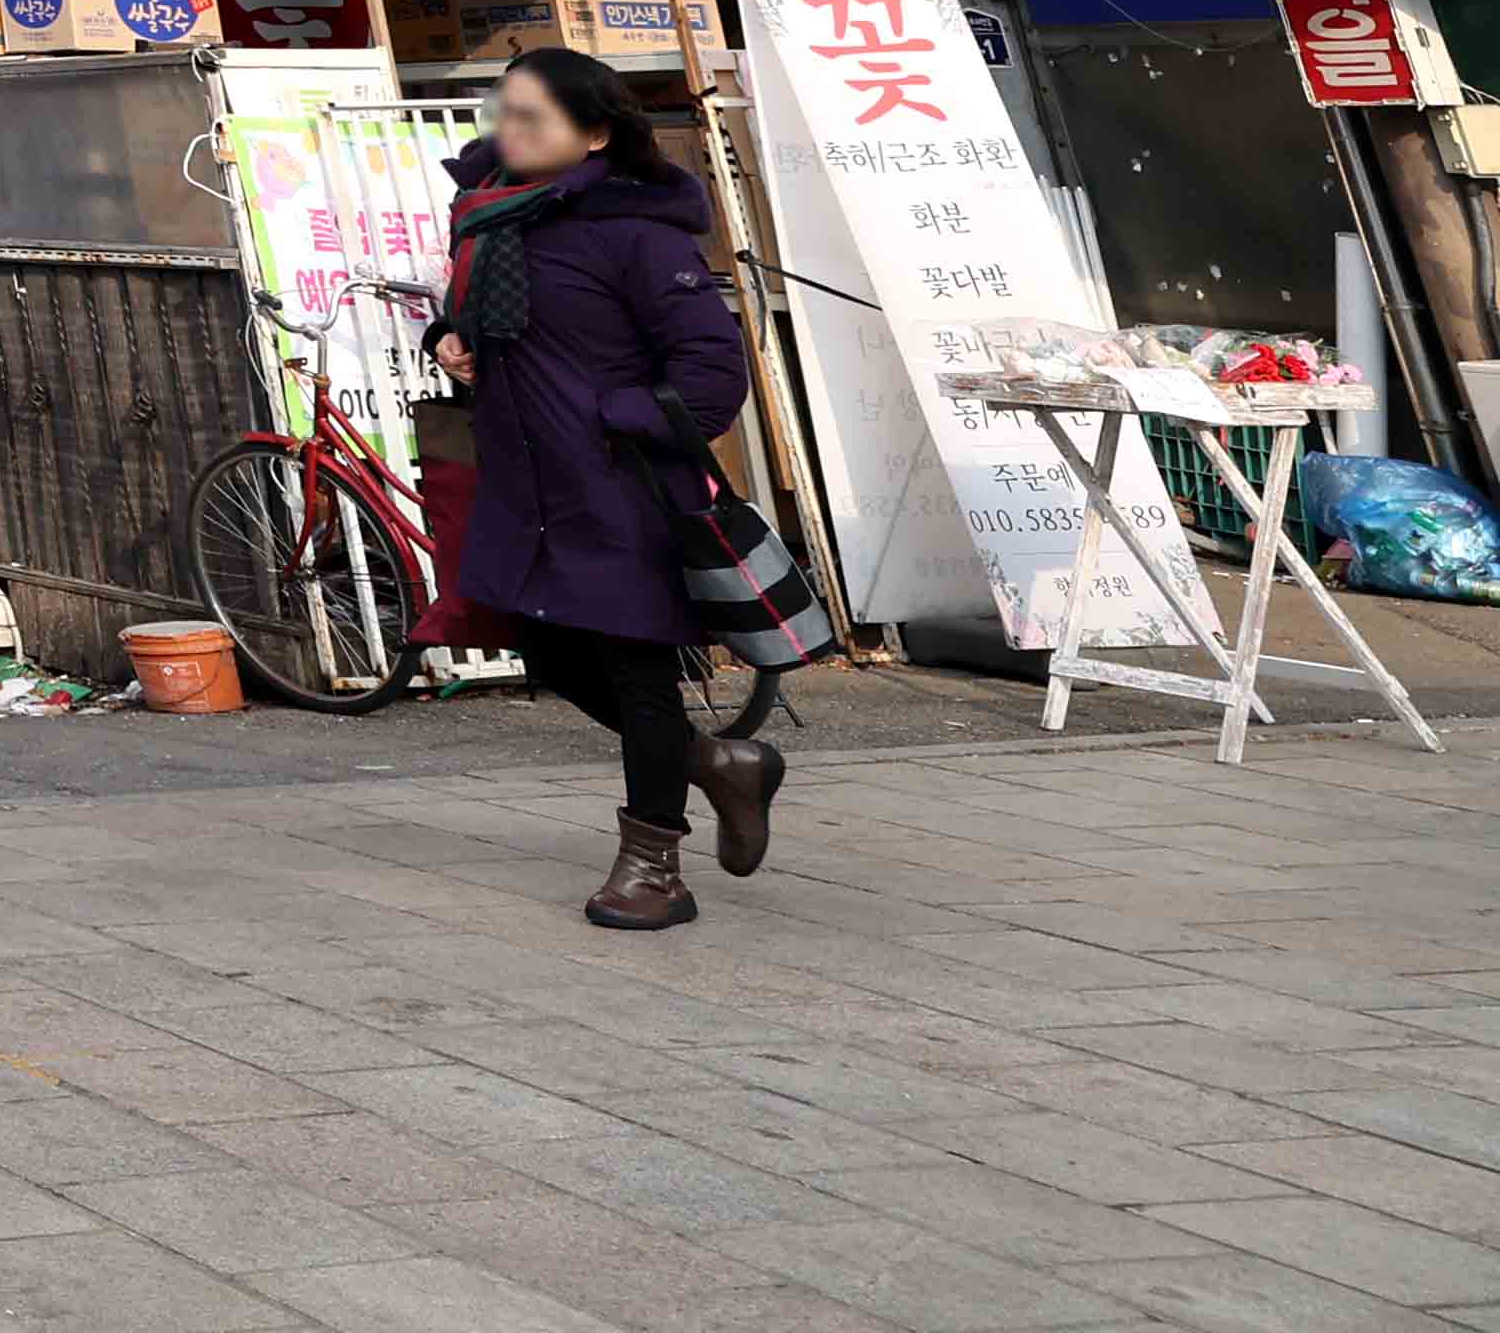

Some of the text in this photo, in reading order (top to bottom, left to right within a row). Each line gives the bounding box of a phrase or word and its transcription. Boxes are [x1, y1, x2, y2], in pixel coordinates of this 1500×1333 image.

[823, 136, 1020, 174] 축하/근조 화환
[908, 200, 972, 235] 화분
[918, 263, 1013, 300] 꽃다발
[991, 460, 1077, 494] 주문예
